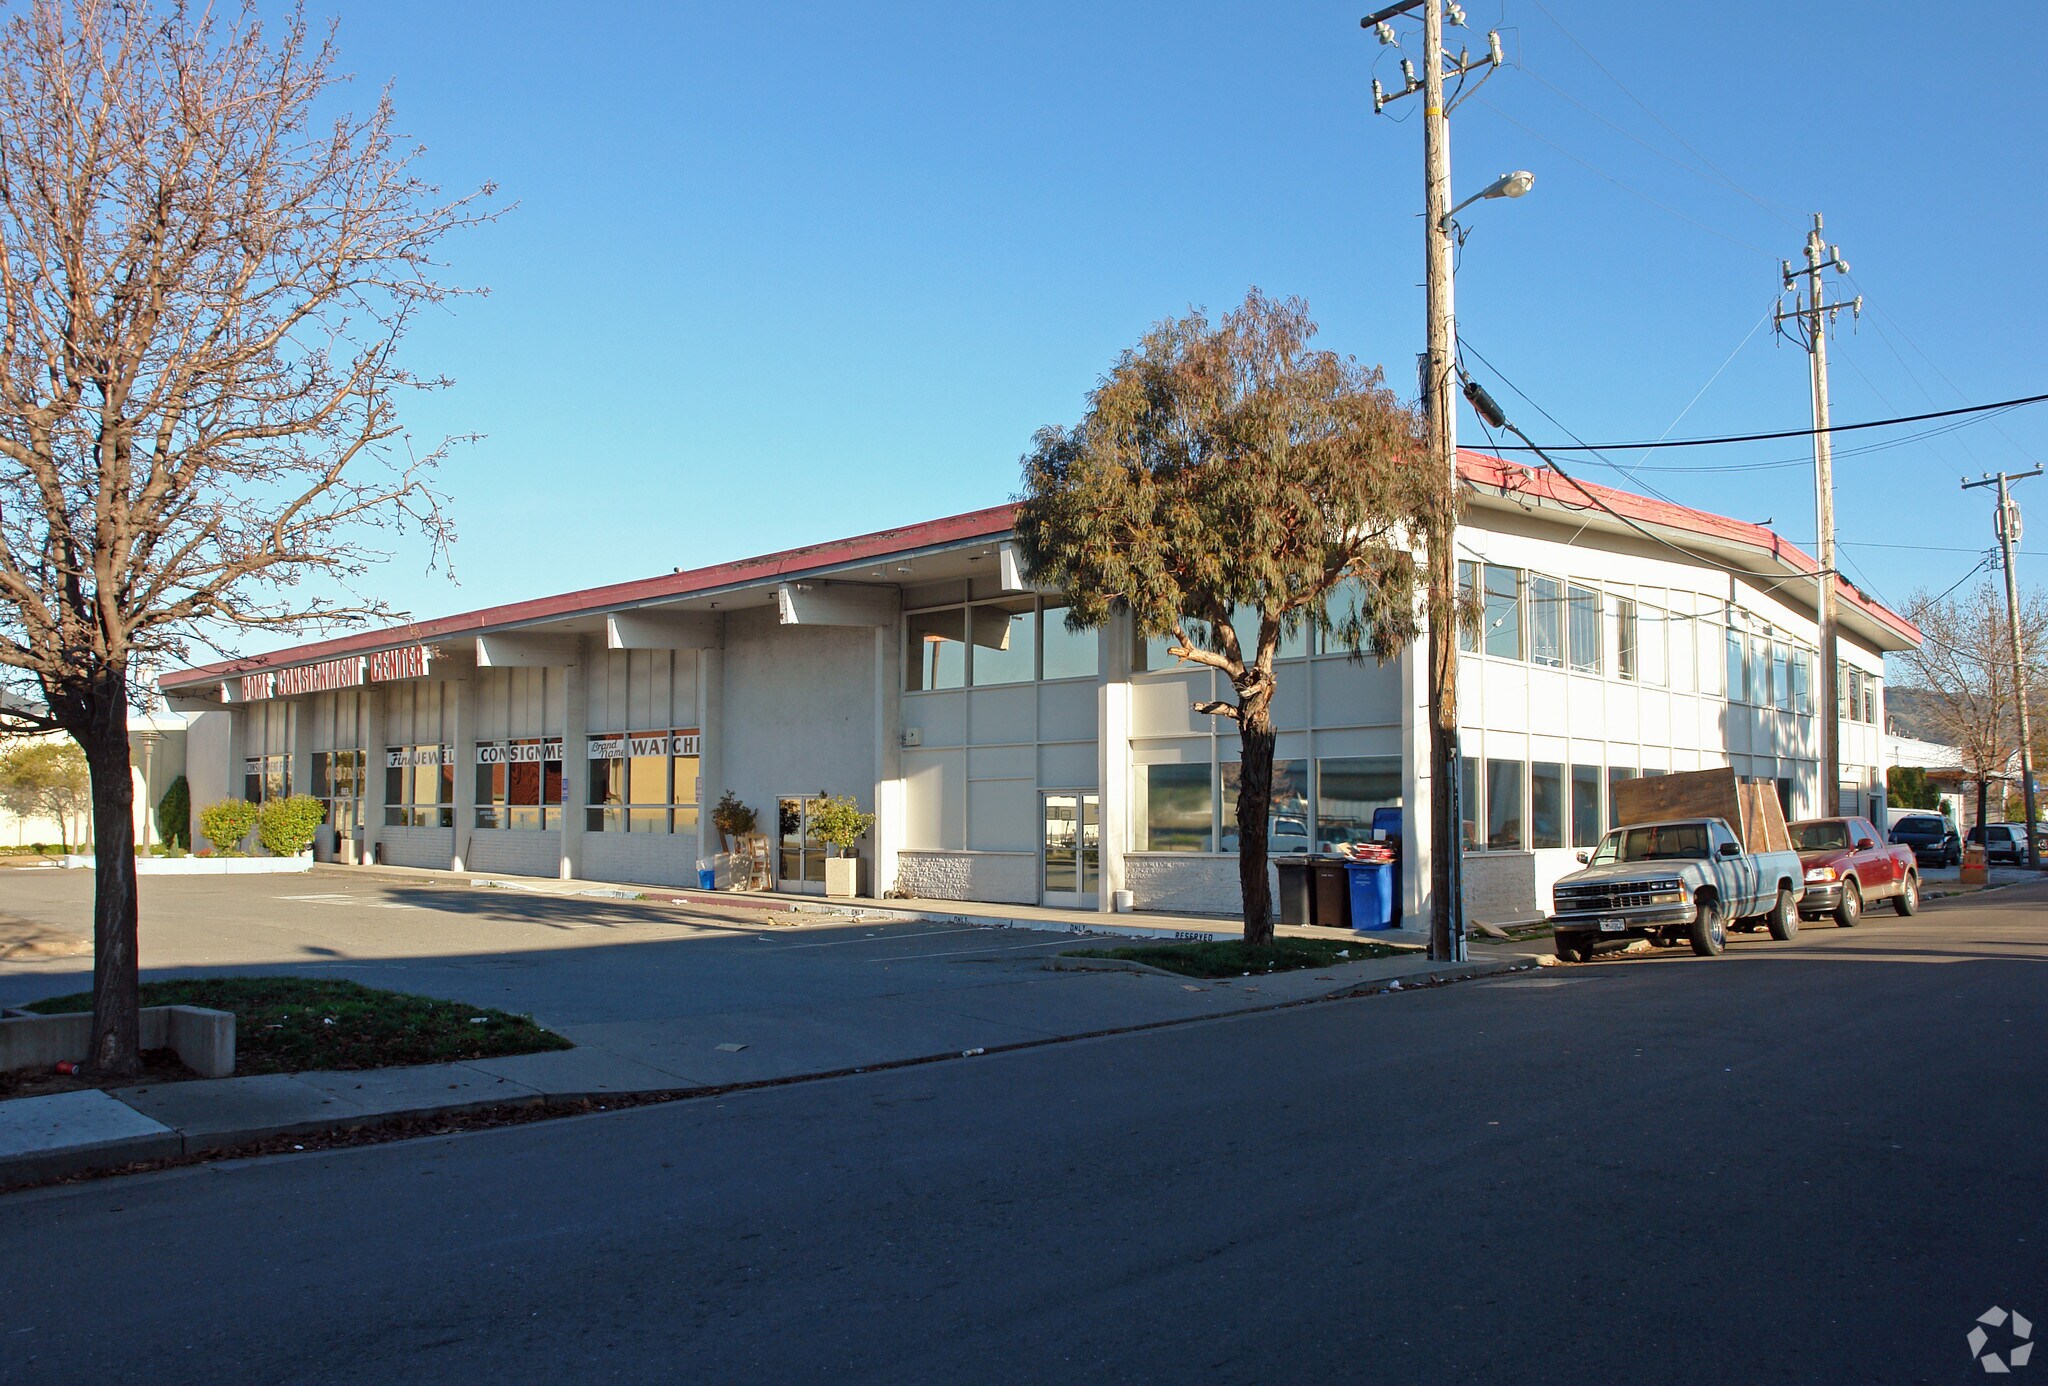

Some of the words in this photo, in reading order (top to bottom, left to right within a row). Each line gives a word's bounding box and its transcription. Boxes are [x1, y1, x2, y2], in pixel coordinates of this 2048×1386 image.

[241, 672, 275, 701] HOME
[277, 656, 366, 695] CONSIGNMENT
[370, 646, 430, 682] CENTER
[591, 740, 617, 752] Brand
[631, 737, 699, 756] WATCH
[1070, 924, 1086, 932] ONLY
[1175, 931, 1213, 942] RESERVED
